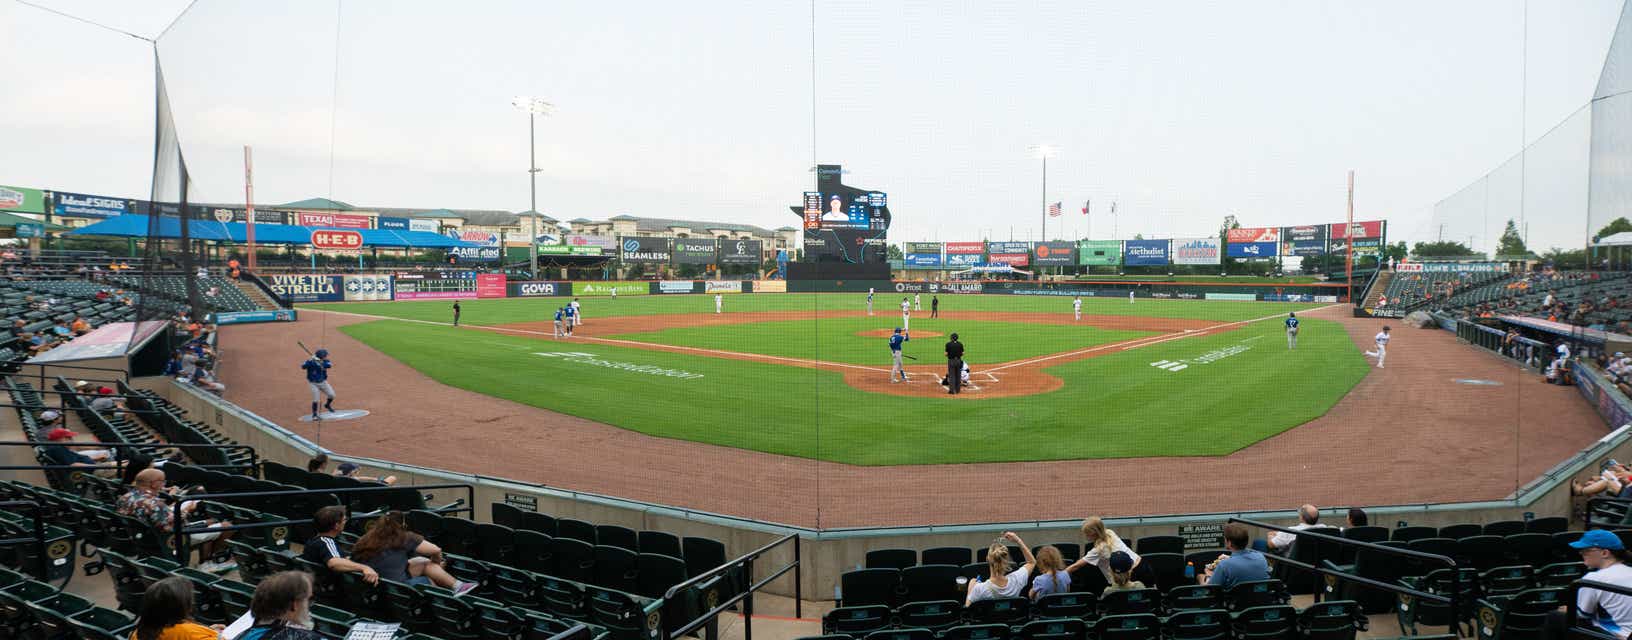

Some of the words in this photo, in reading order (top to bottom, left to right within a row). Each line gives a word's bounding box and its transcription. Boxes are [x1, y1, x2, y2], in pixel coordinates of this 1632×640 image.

[303, 215, 333, 224] TEXAS
[1129, 247, 1164, 255] Methodist
[624, 252, 668, 260] SEAMLESS
[272, 276, 306, 285] VIVE
[311, 276, 327, 285] TU
[271, 284, 335, 294] ESTRELLA
[521, 284, 554, 293] GOYA
[905, 283, 921, 291] Frost
[1373, 308, 1394, 317] FINE
